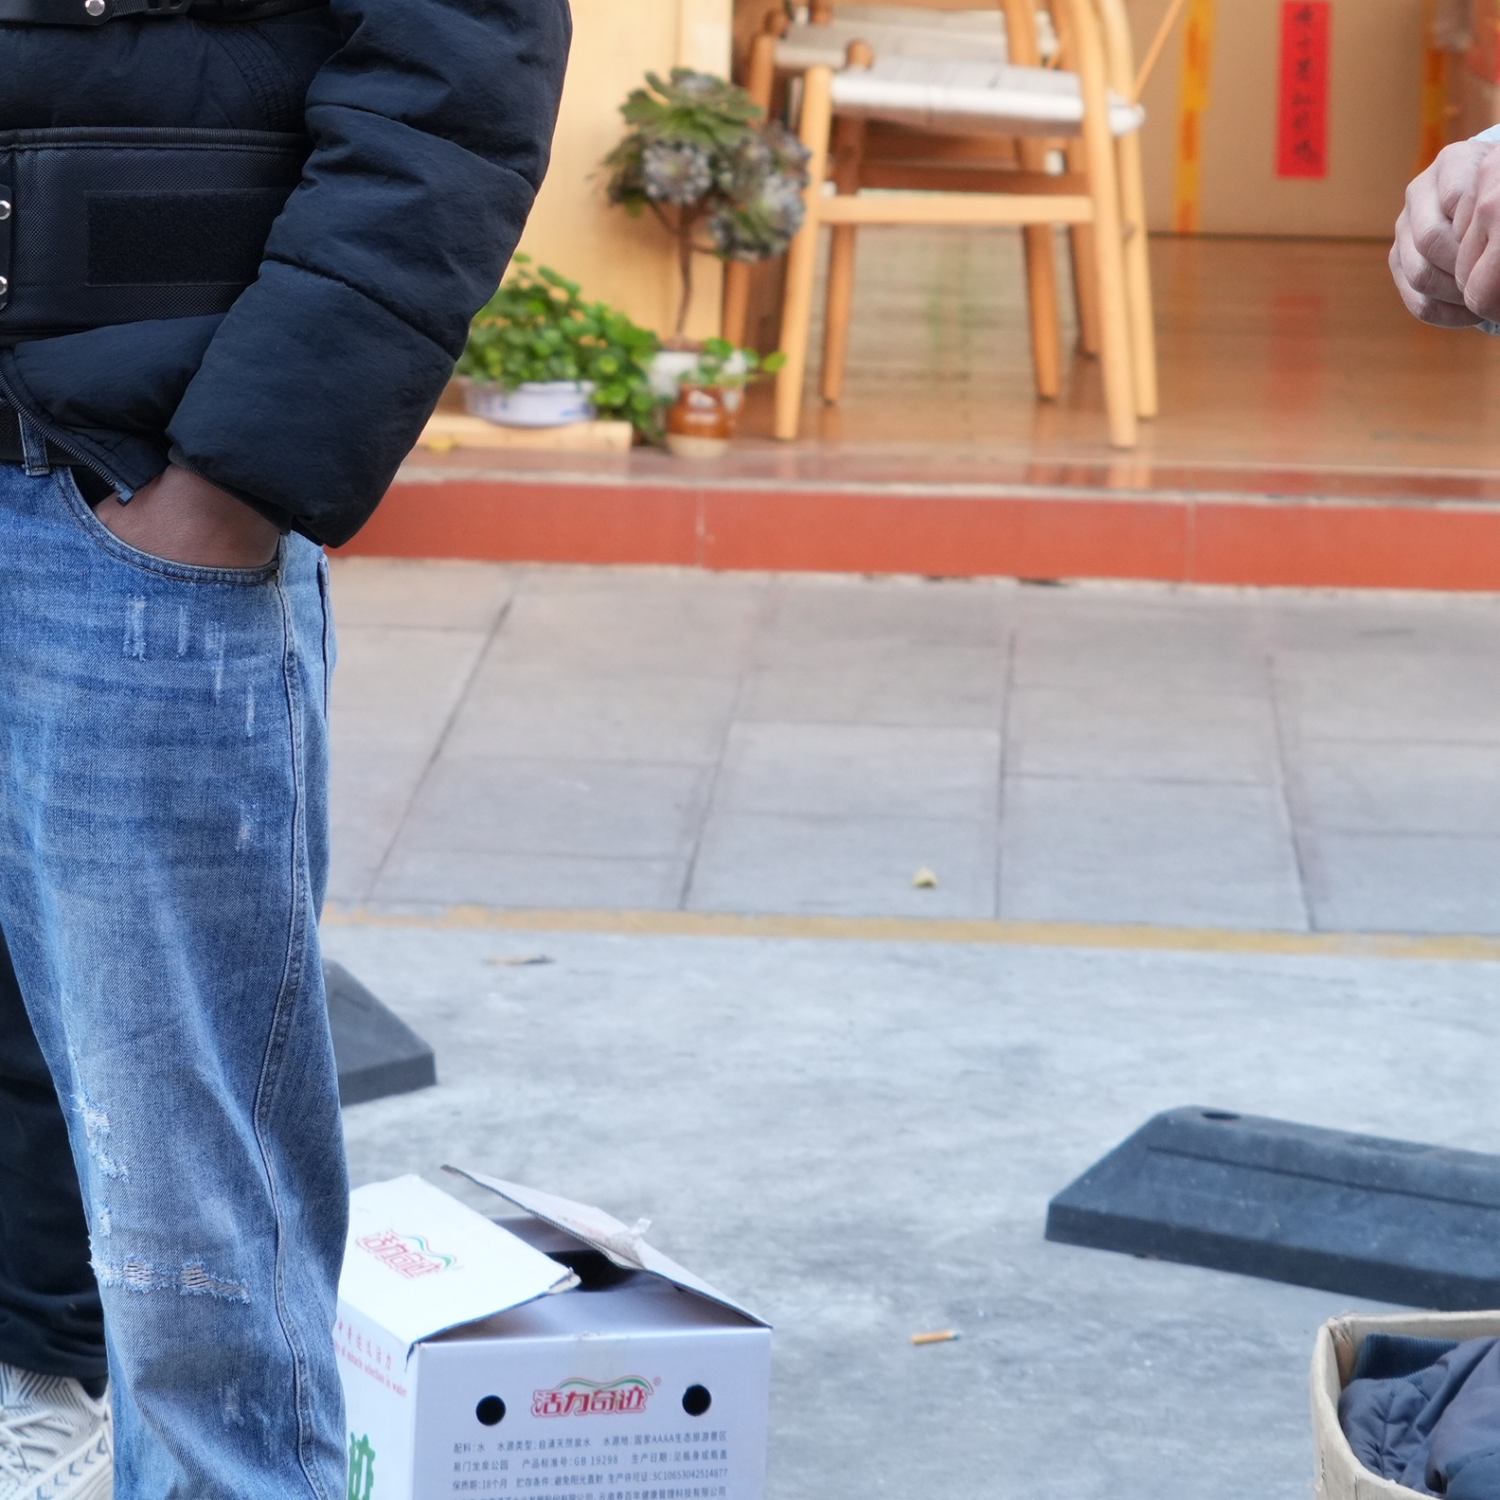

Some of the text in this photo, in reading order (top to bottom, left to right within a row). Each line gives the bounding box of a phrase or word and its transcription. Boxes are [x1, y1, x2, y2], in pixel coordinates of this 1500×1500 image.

[531, 1384, 649, 1418] 活力奇迹
[591, 1455, 619, 1466] 19298
